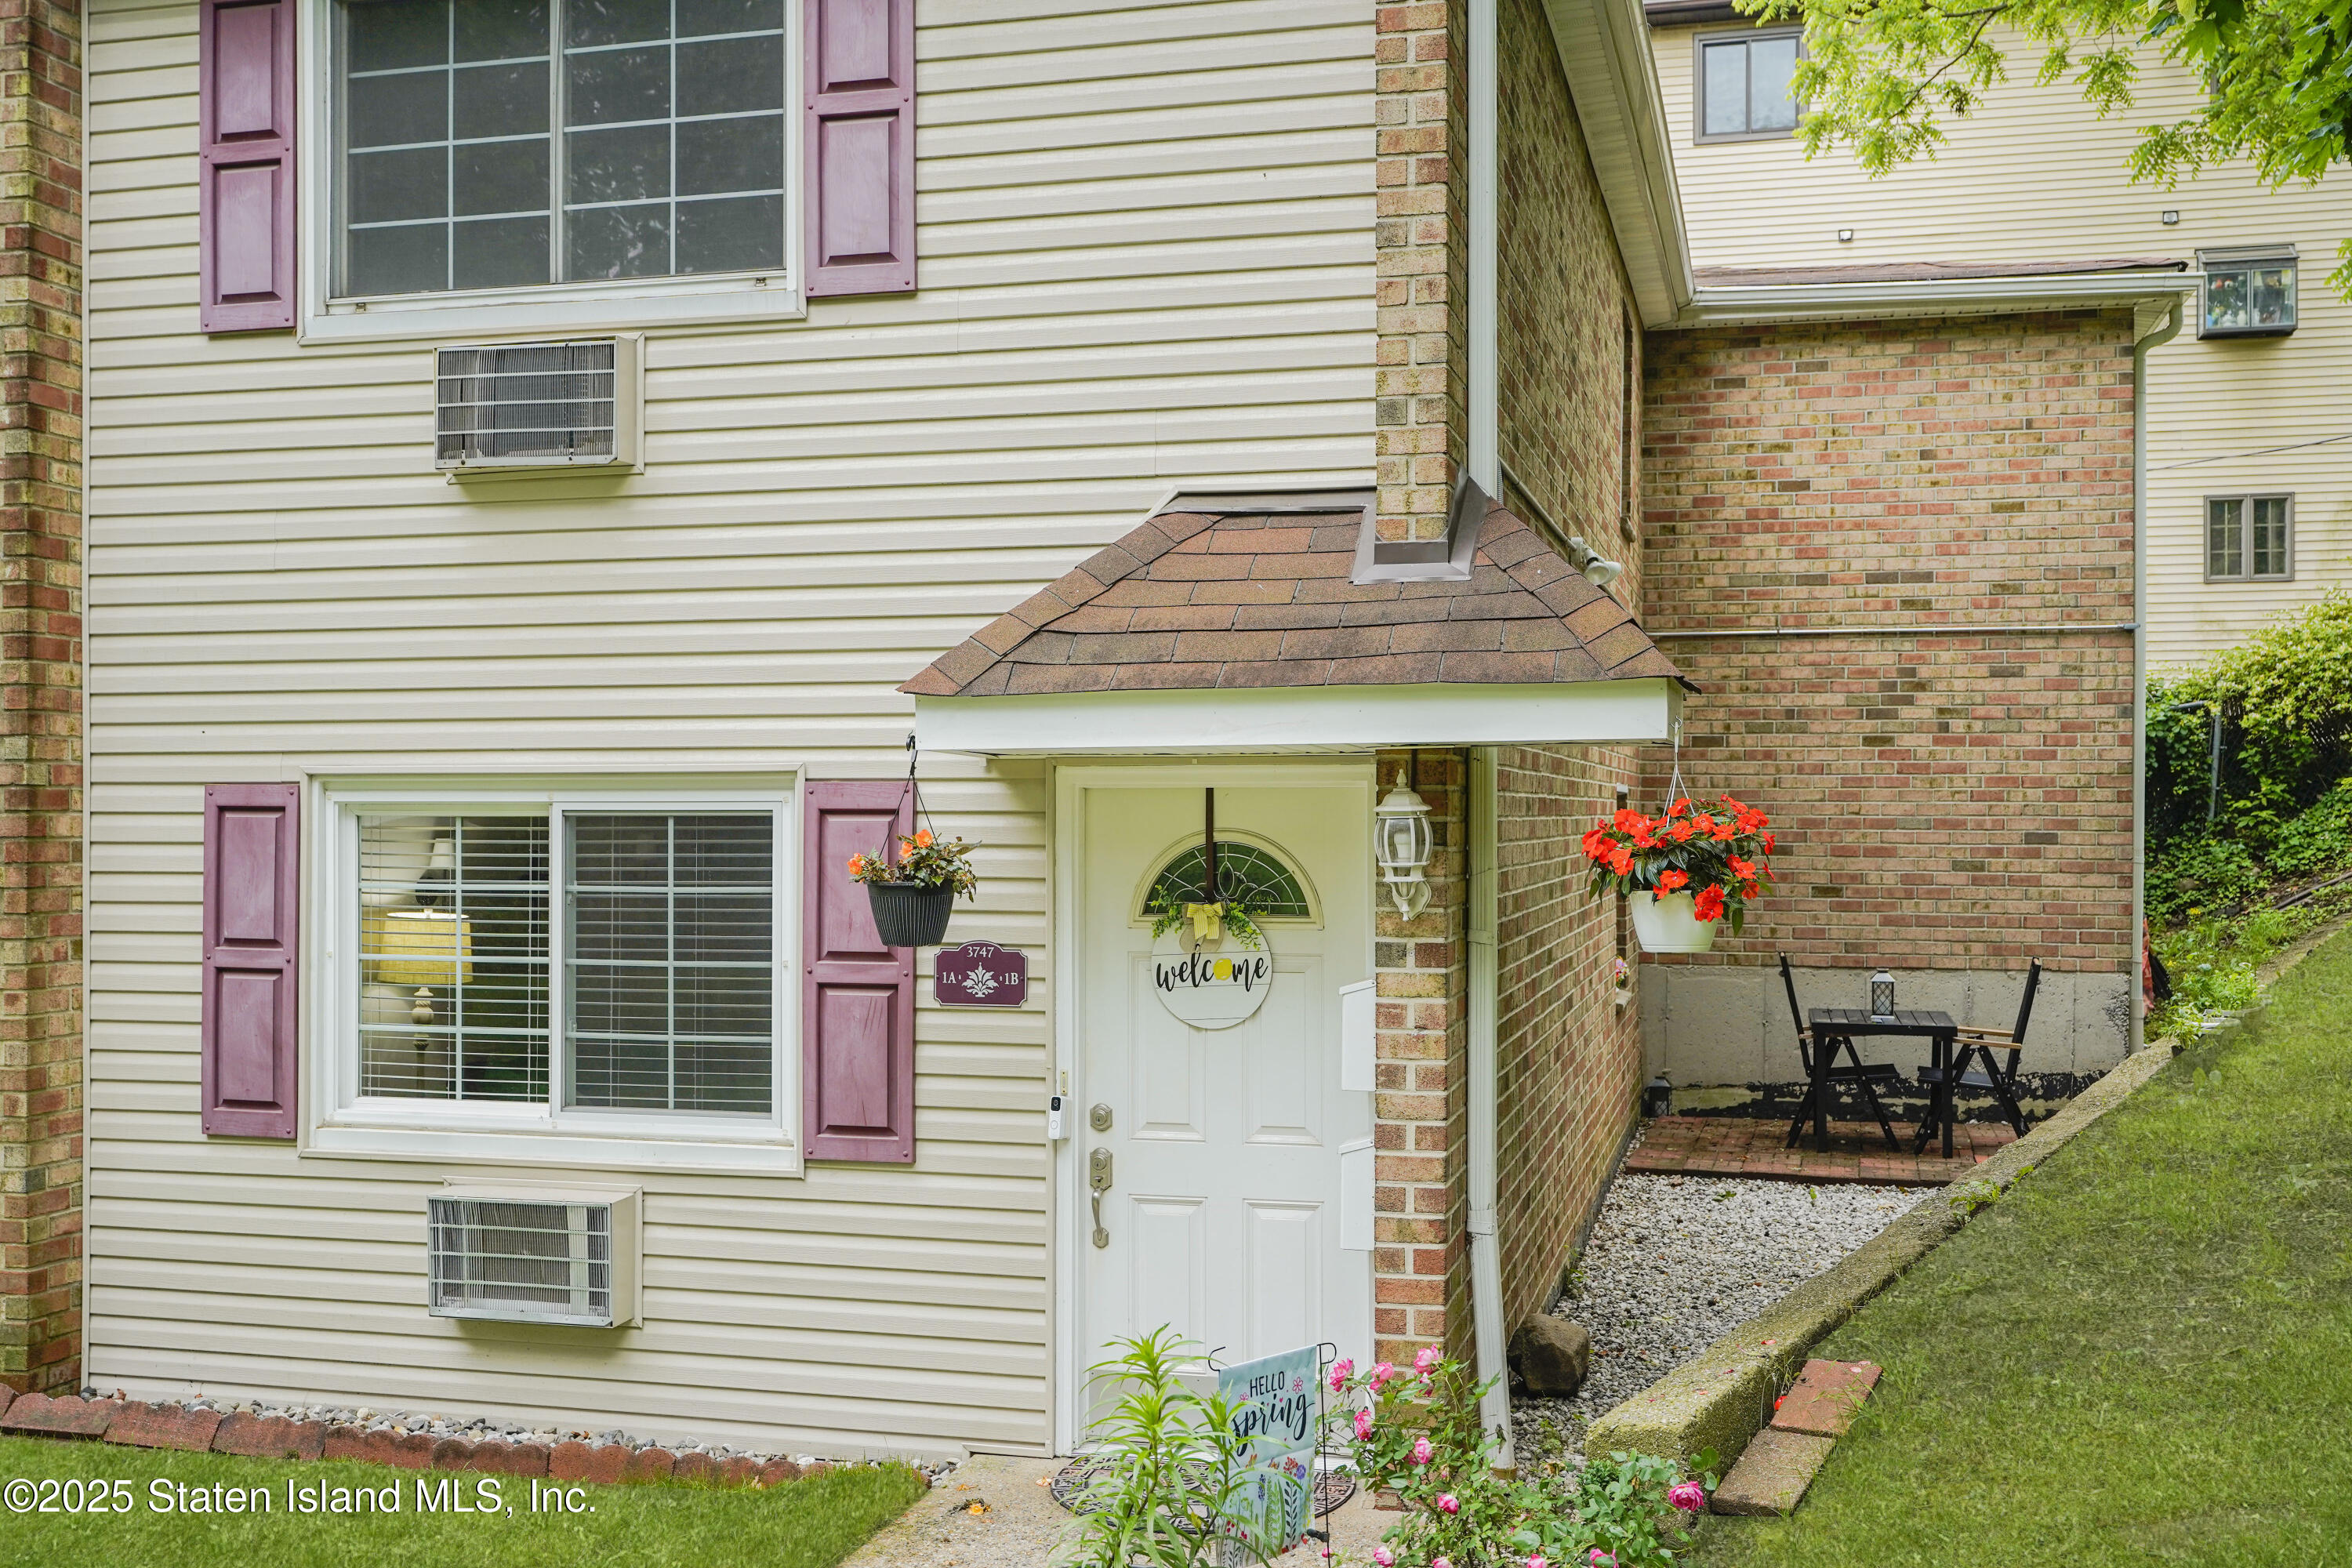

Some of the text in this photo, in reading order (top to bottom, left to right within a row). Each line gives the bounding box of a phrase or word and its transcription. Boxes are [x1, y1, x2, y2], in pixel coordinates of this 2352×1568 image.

[967, 946, 994, 958] 3747
[942, 971, 956, 984] 1A
[1004, 972, 1019, 985] 1B
[1250, 1370, 1286, 1398] HELLO
[1229, 1392, 1316, 1457] spring
